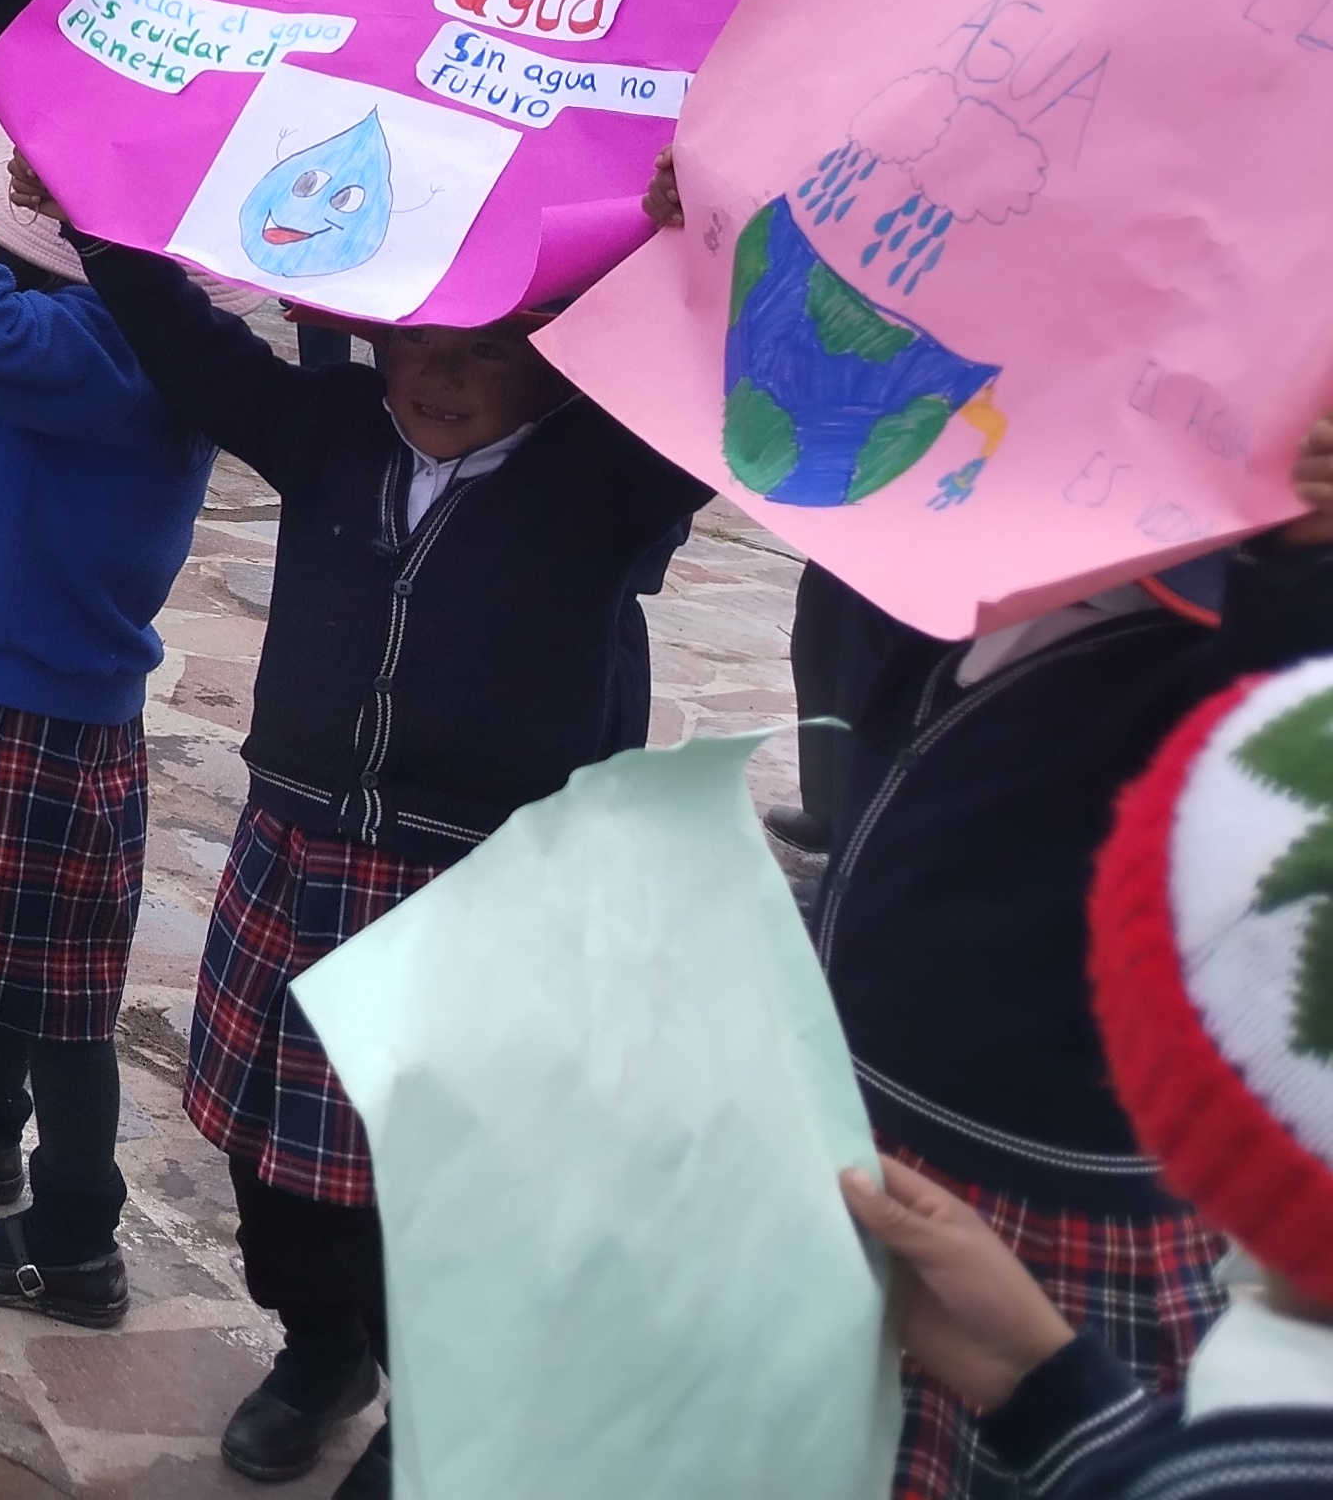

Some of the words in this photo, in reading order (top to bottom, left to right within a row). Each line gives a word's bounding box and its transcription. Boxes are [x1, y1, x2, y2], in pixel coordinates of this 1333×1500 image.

[131, 19, 231, 64] cuidar
[246, 43, 278, 67] el
[220, 10, 248, 34] el
[270, 23, 341, 47] agua
[444, 32, 505, 73] Sin
[524, 64, 597, 94] agua
[621, 76, 656, 99] no
[1062, 450, 1132, 508] ES
